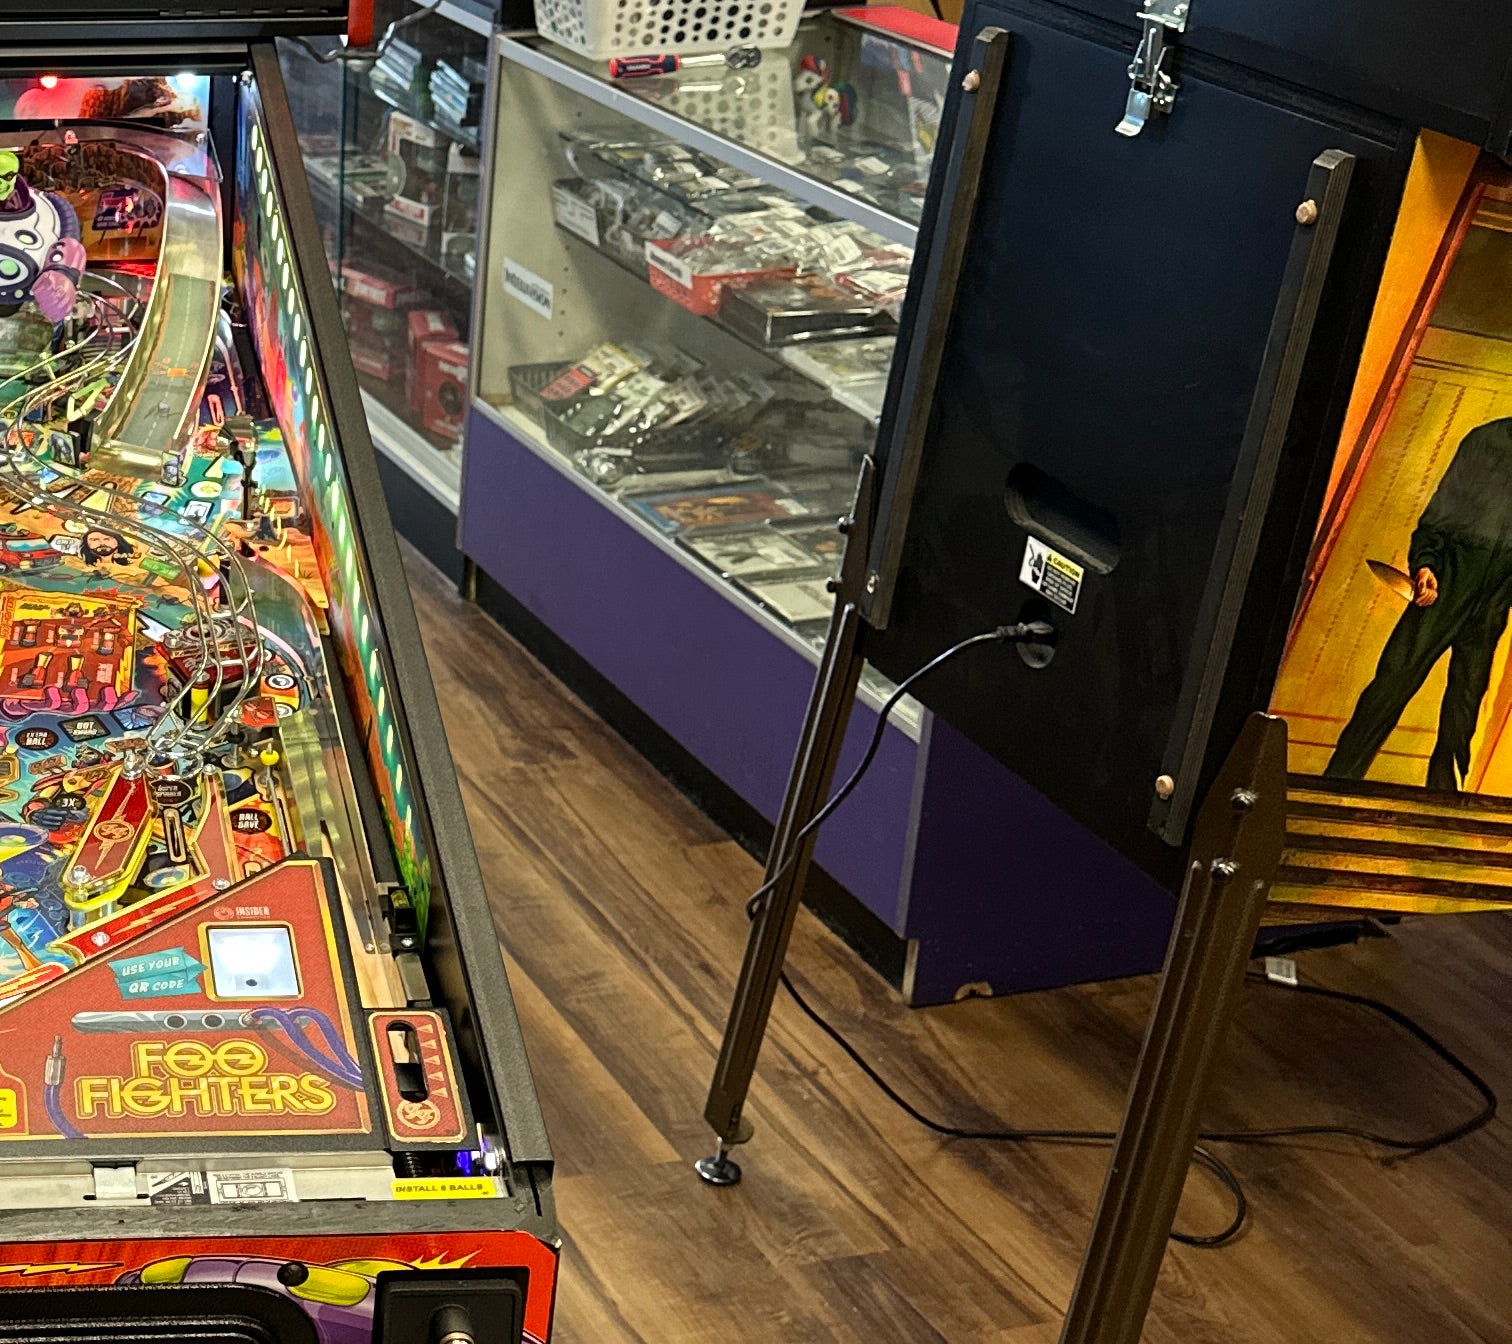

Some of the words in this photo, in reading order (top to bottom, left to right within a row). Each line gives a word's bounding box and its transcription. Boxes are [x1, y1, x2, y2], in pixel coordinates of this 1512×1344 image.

[25, 737, 47, 747] BALL
[61, 798, 75, 808] 3X
[238, 813, 259, 821] BALL
[235, 906, 271, 917] INSIDER
[122, 962, 146, 976] USE
[147, 956, 181, 972] YOUR
[128, 980, 150, 994] QR
[151, 978, 185, 992] CODE
[135, 1041, 266, 1074] FOO
[78, 1075, 336, 1117] FIGHTERS
[395, 1184, 437, 1193] INSTALL
[449, 1183, 484, 1192] BALLS
